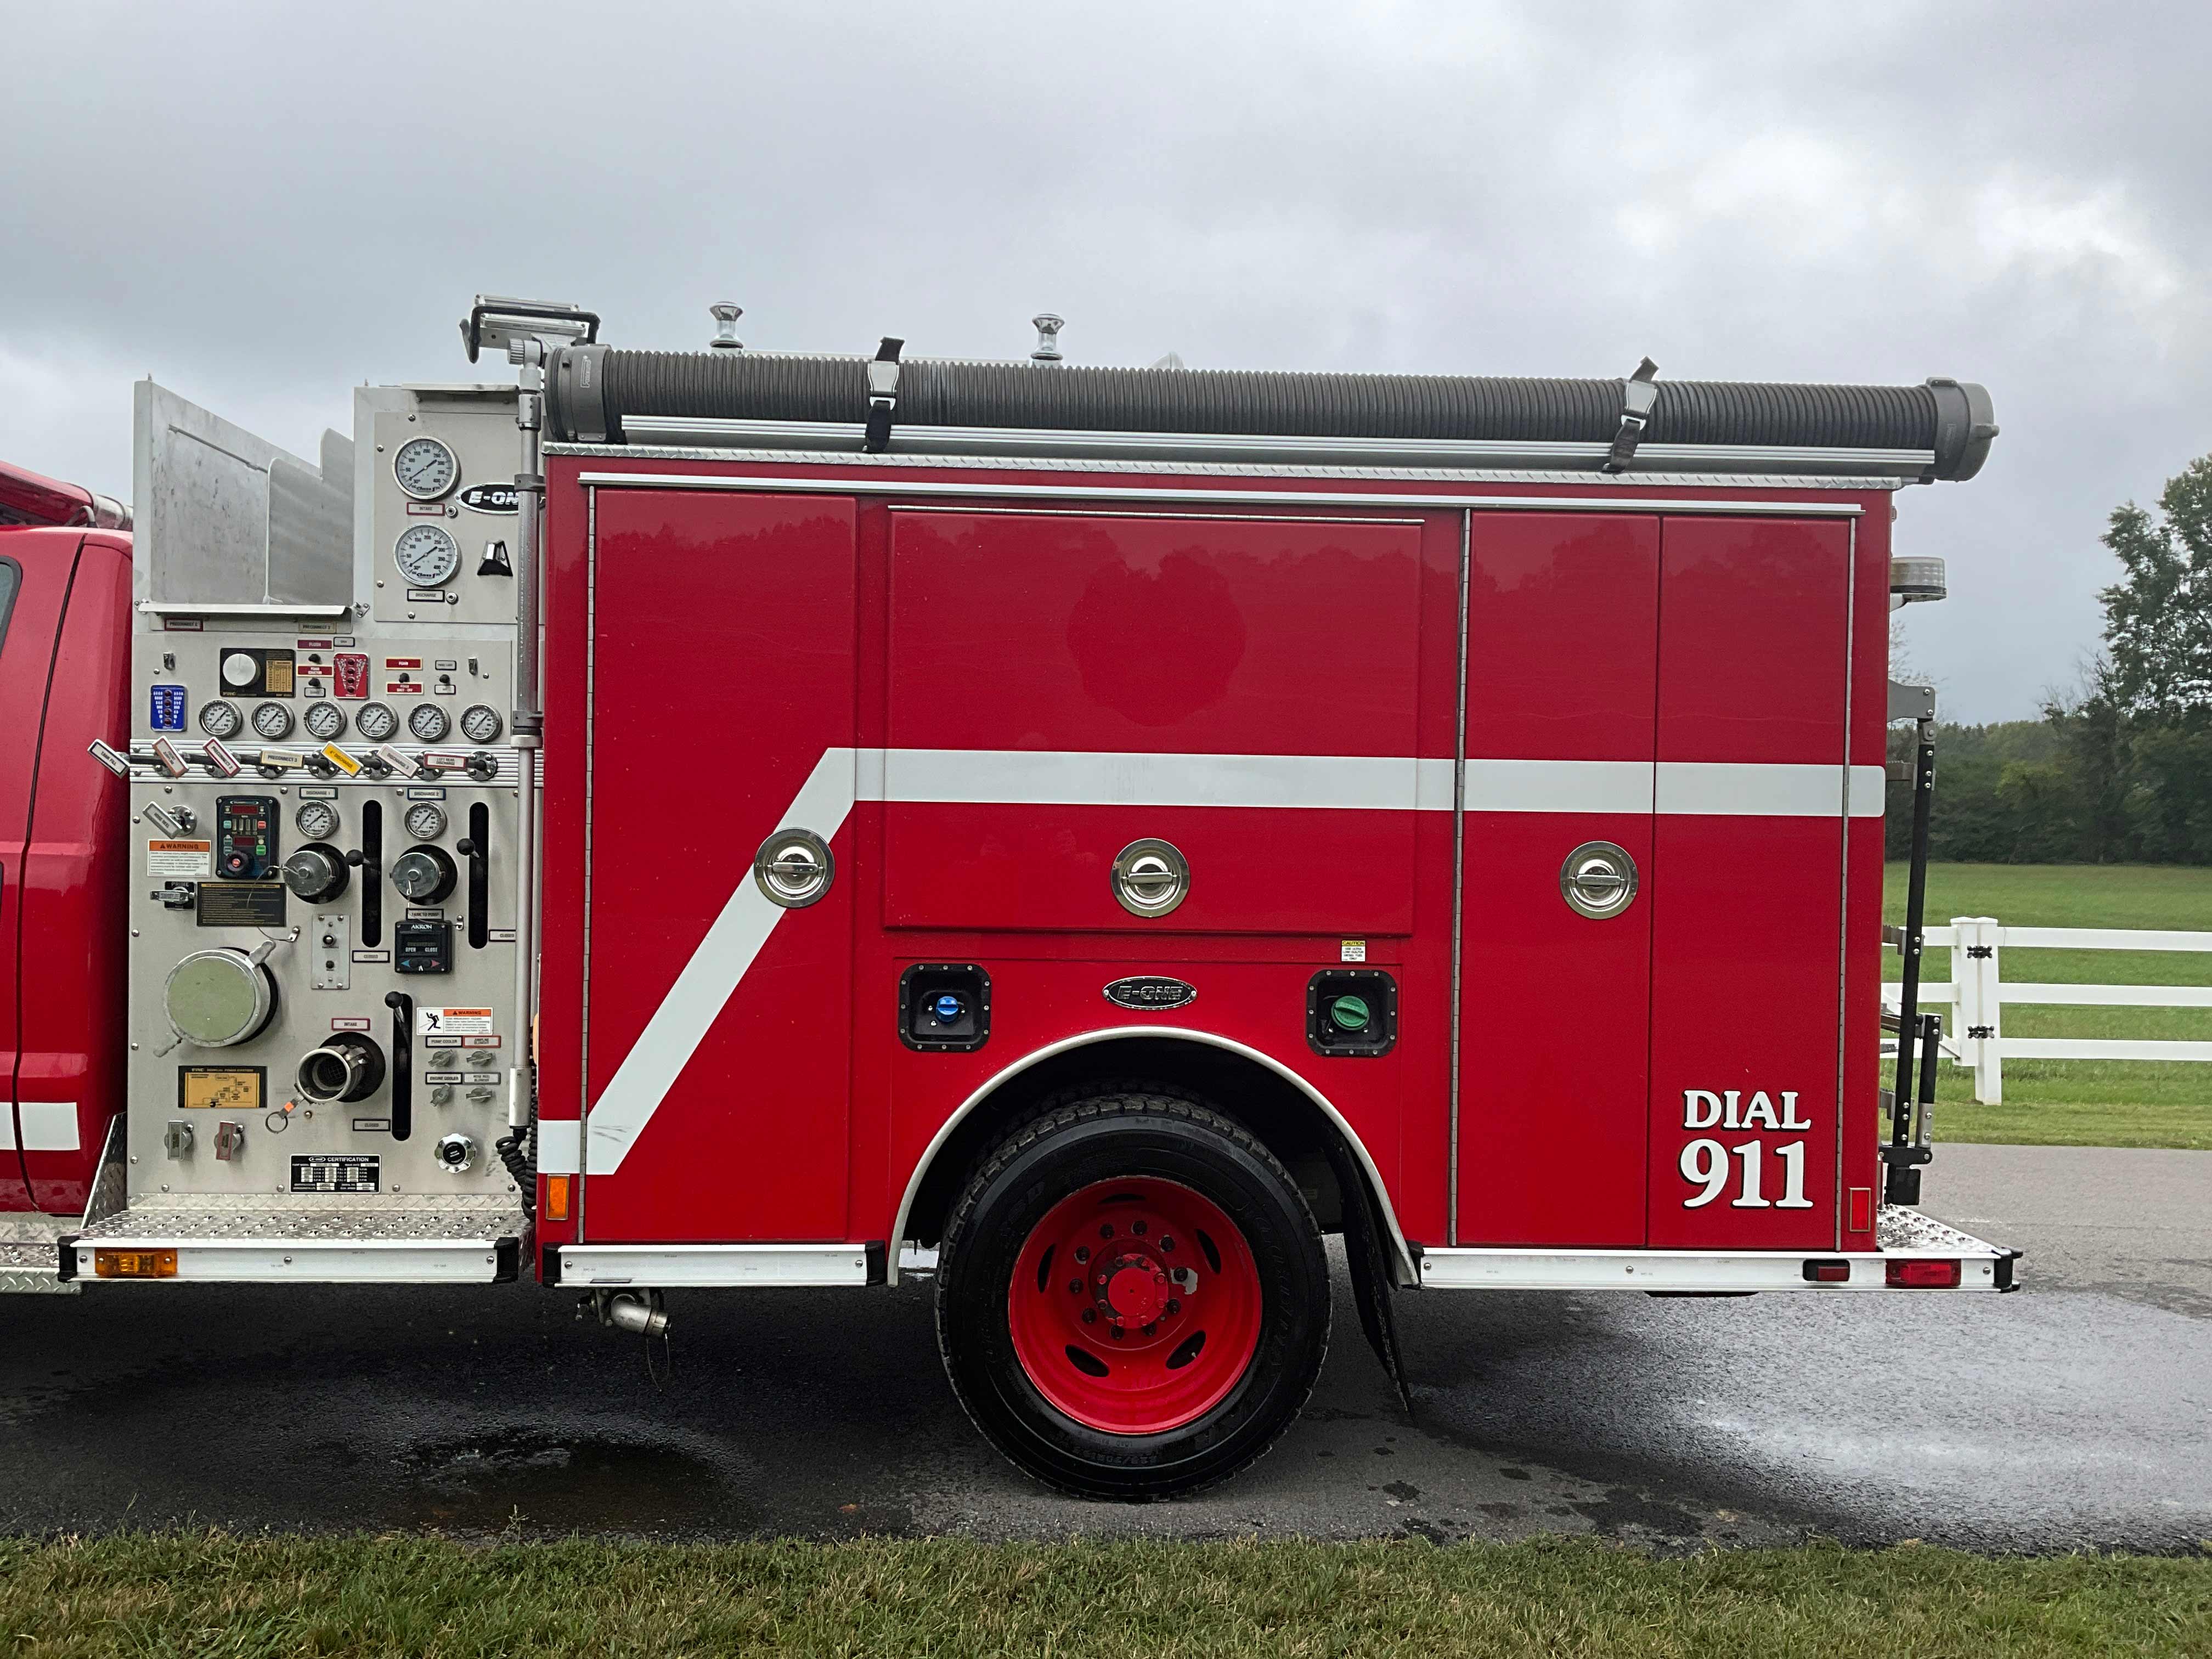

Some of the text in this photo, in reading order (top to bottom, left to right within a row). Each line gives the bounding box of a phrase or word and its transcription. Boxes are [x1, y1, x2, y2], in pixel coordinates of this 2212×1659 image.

[211, 746, 232, 768] PRECONNECT
[1117, 986, 1183, 1000] E-ONE
[1683, 1090, 1811, 1130] DIAL
[1679, 1138, 1813, 1208] 911
